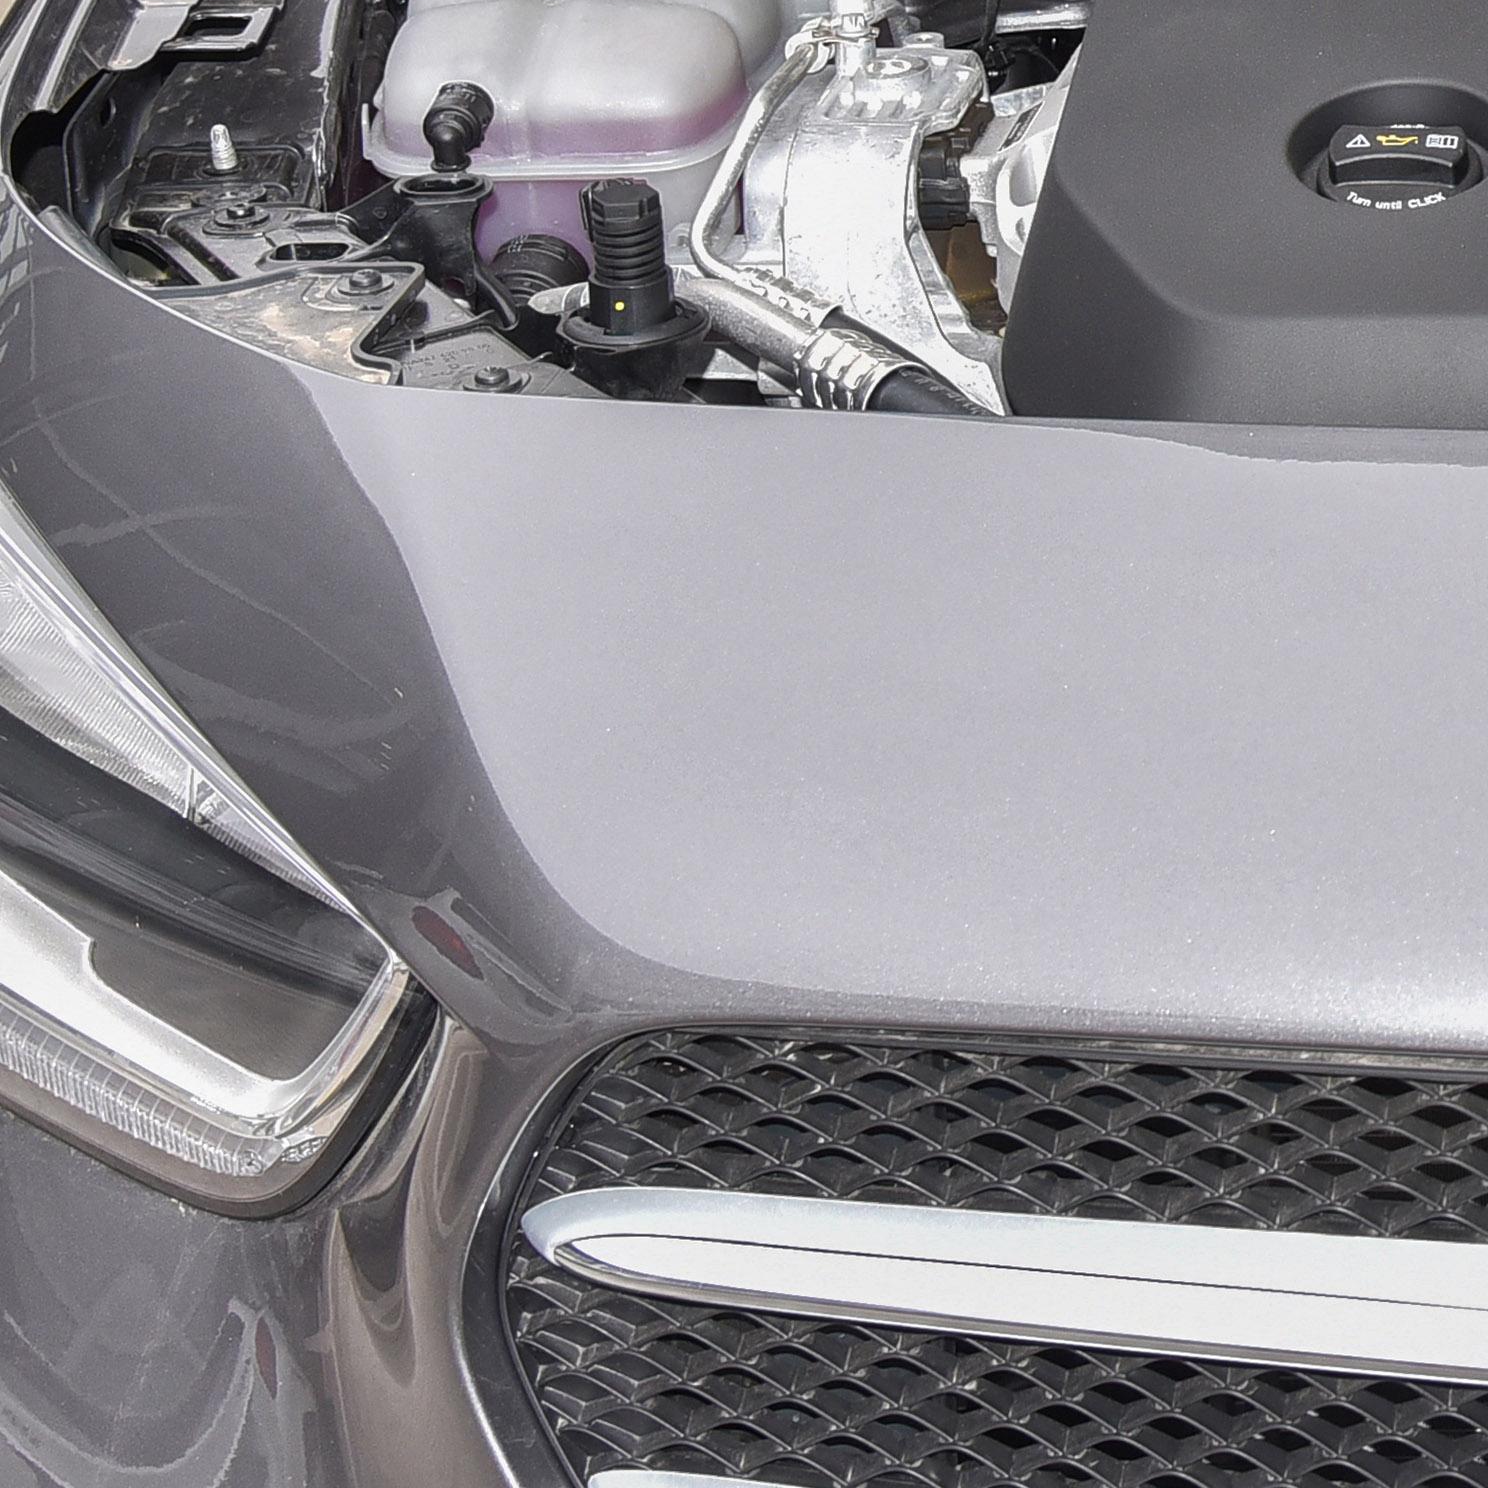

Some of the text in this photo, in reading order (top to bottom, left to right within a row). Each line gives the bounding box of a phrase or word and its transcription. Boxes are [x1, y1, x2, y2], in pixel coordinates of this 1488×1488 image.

[1347, 191, 1447, 210] Turn until CLICK
